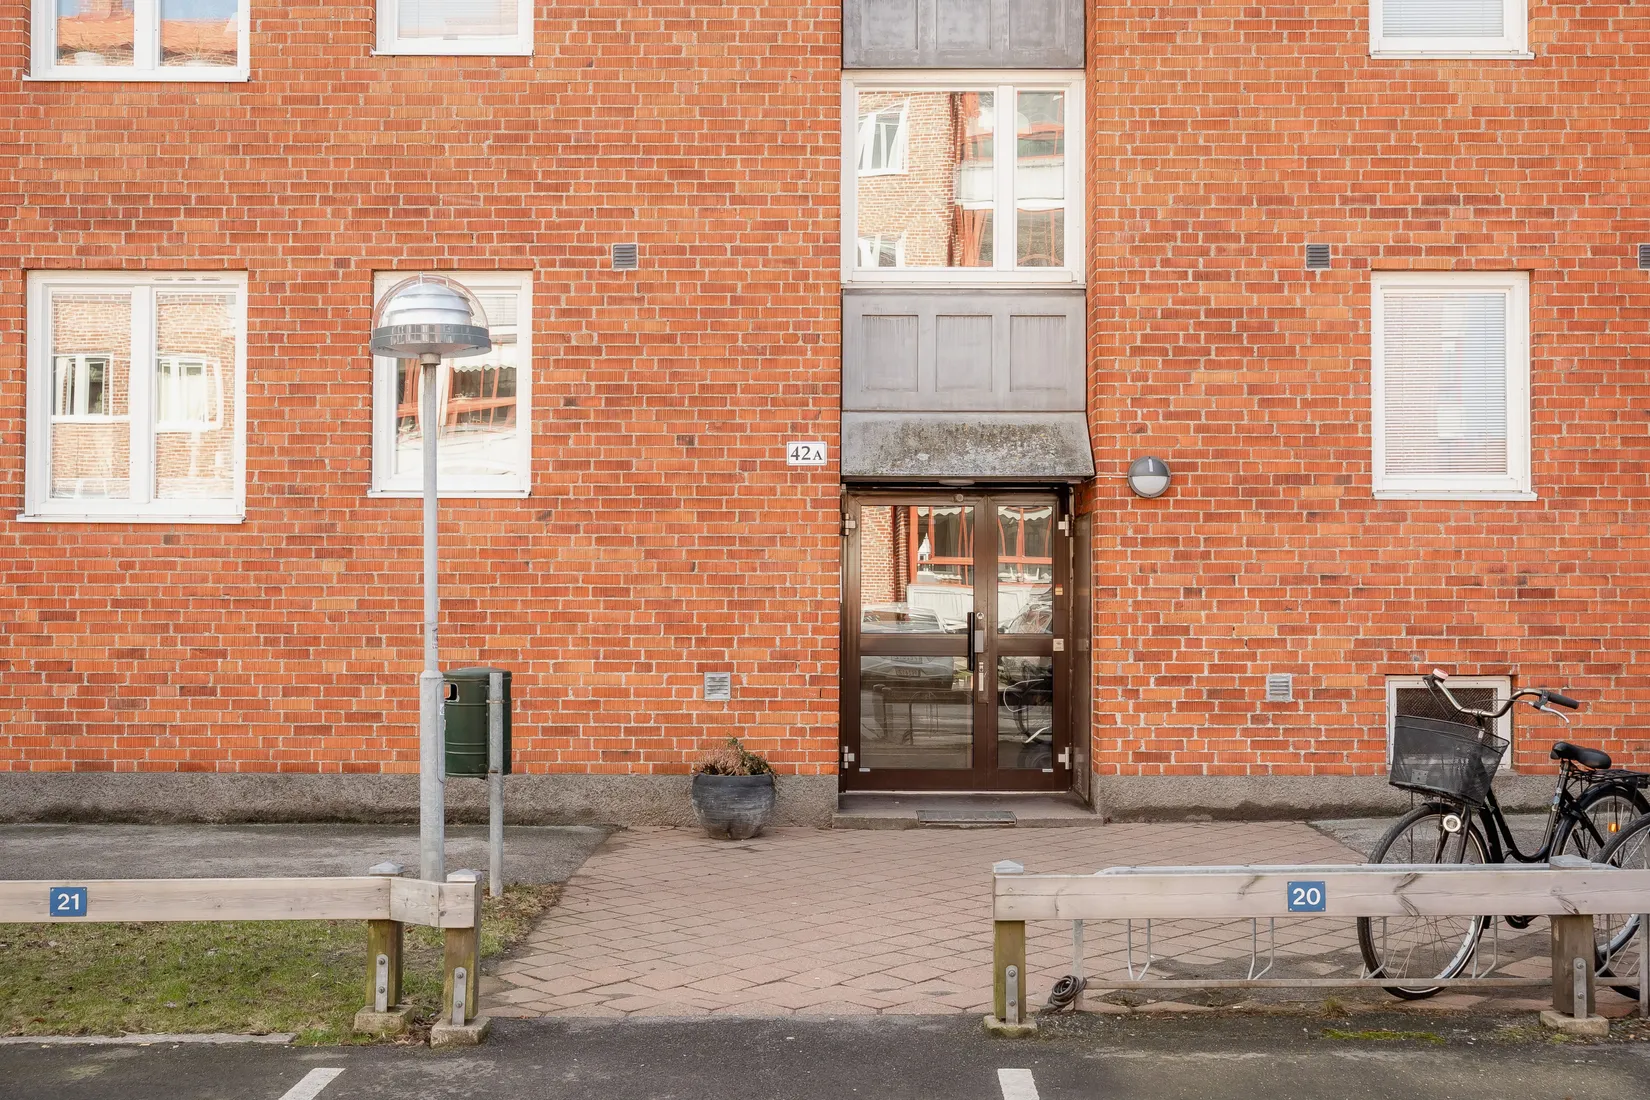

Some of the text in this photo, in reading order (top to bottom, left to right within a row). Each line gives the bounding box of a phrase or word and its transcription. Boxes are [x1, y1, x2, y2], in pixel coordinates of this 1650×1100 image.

[790, 446, 823, 461] 42A
[57, 893, 80, 911] 21
[1293, 887, 1321, 906] 20
